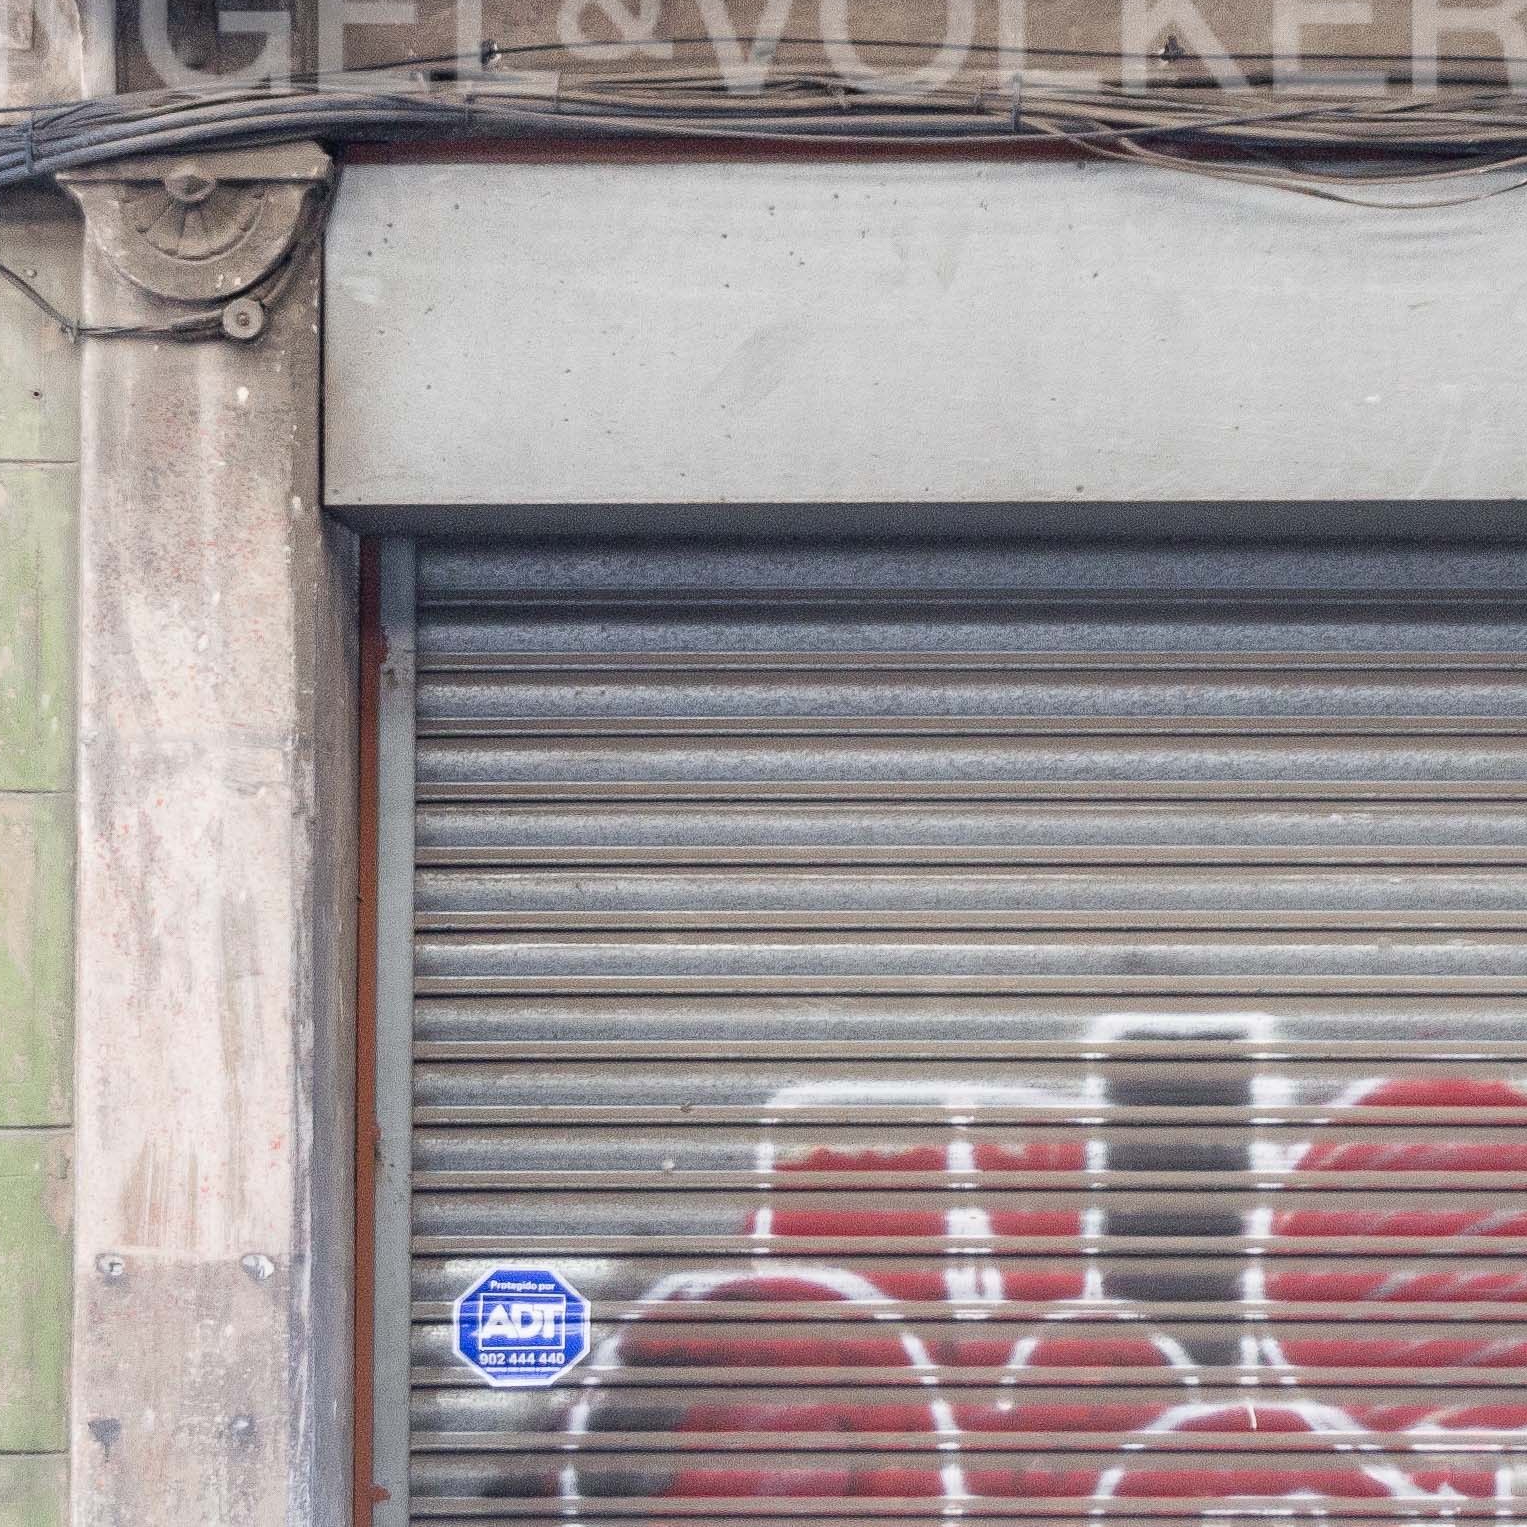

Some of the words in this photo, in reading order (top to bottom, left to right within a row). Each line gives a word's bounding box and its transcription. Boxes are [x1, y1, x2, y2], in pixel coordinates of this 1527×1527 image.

[538, 1282, 556, 1291] por
[479, 1303, 564, 1340] ADT
[479, 1352, 506, 1365] 902
[508, 1352, 536, 1365] 444
[538, 1352, 566, 1365] 440
